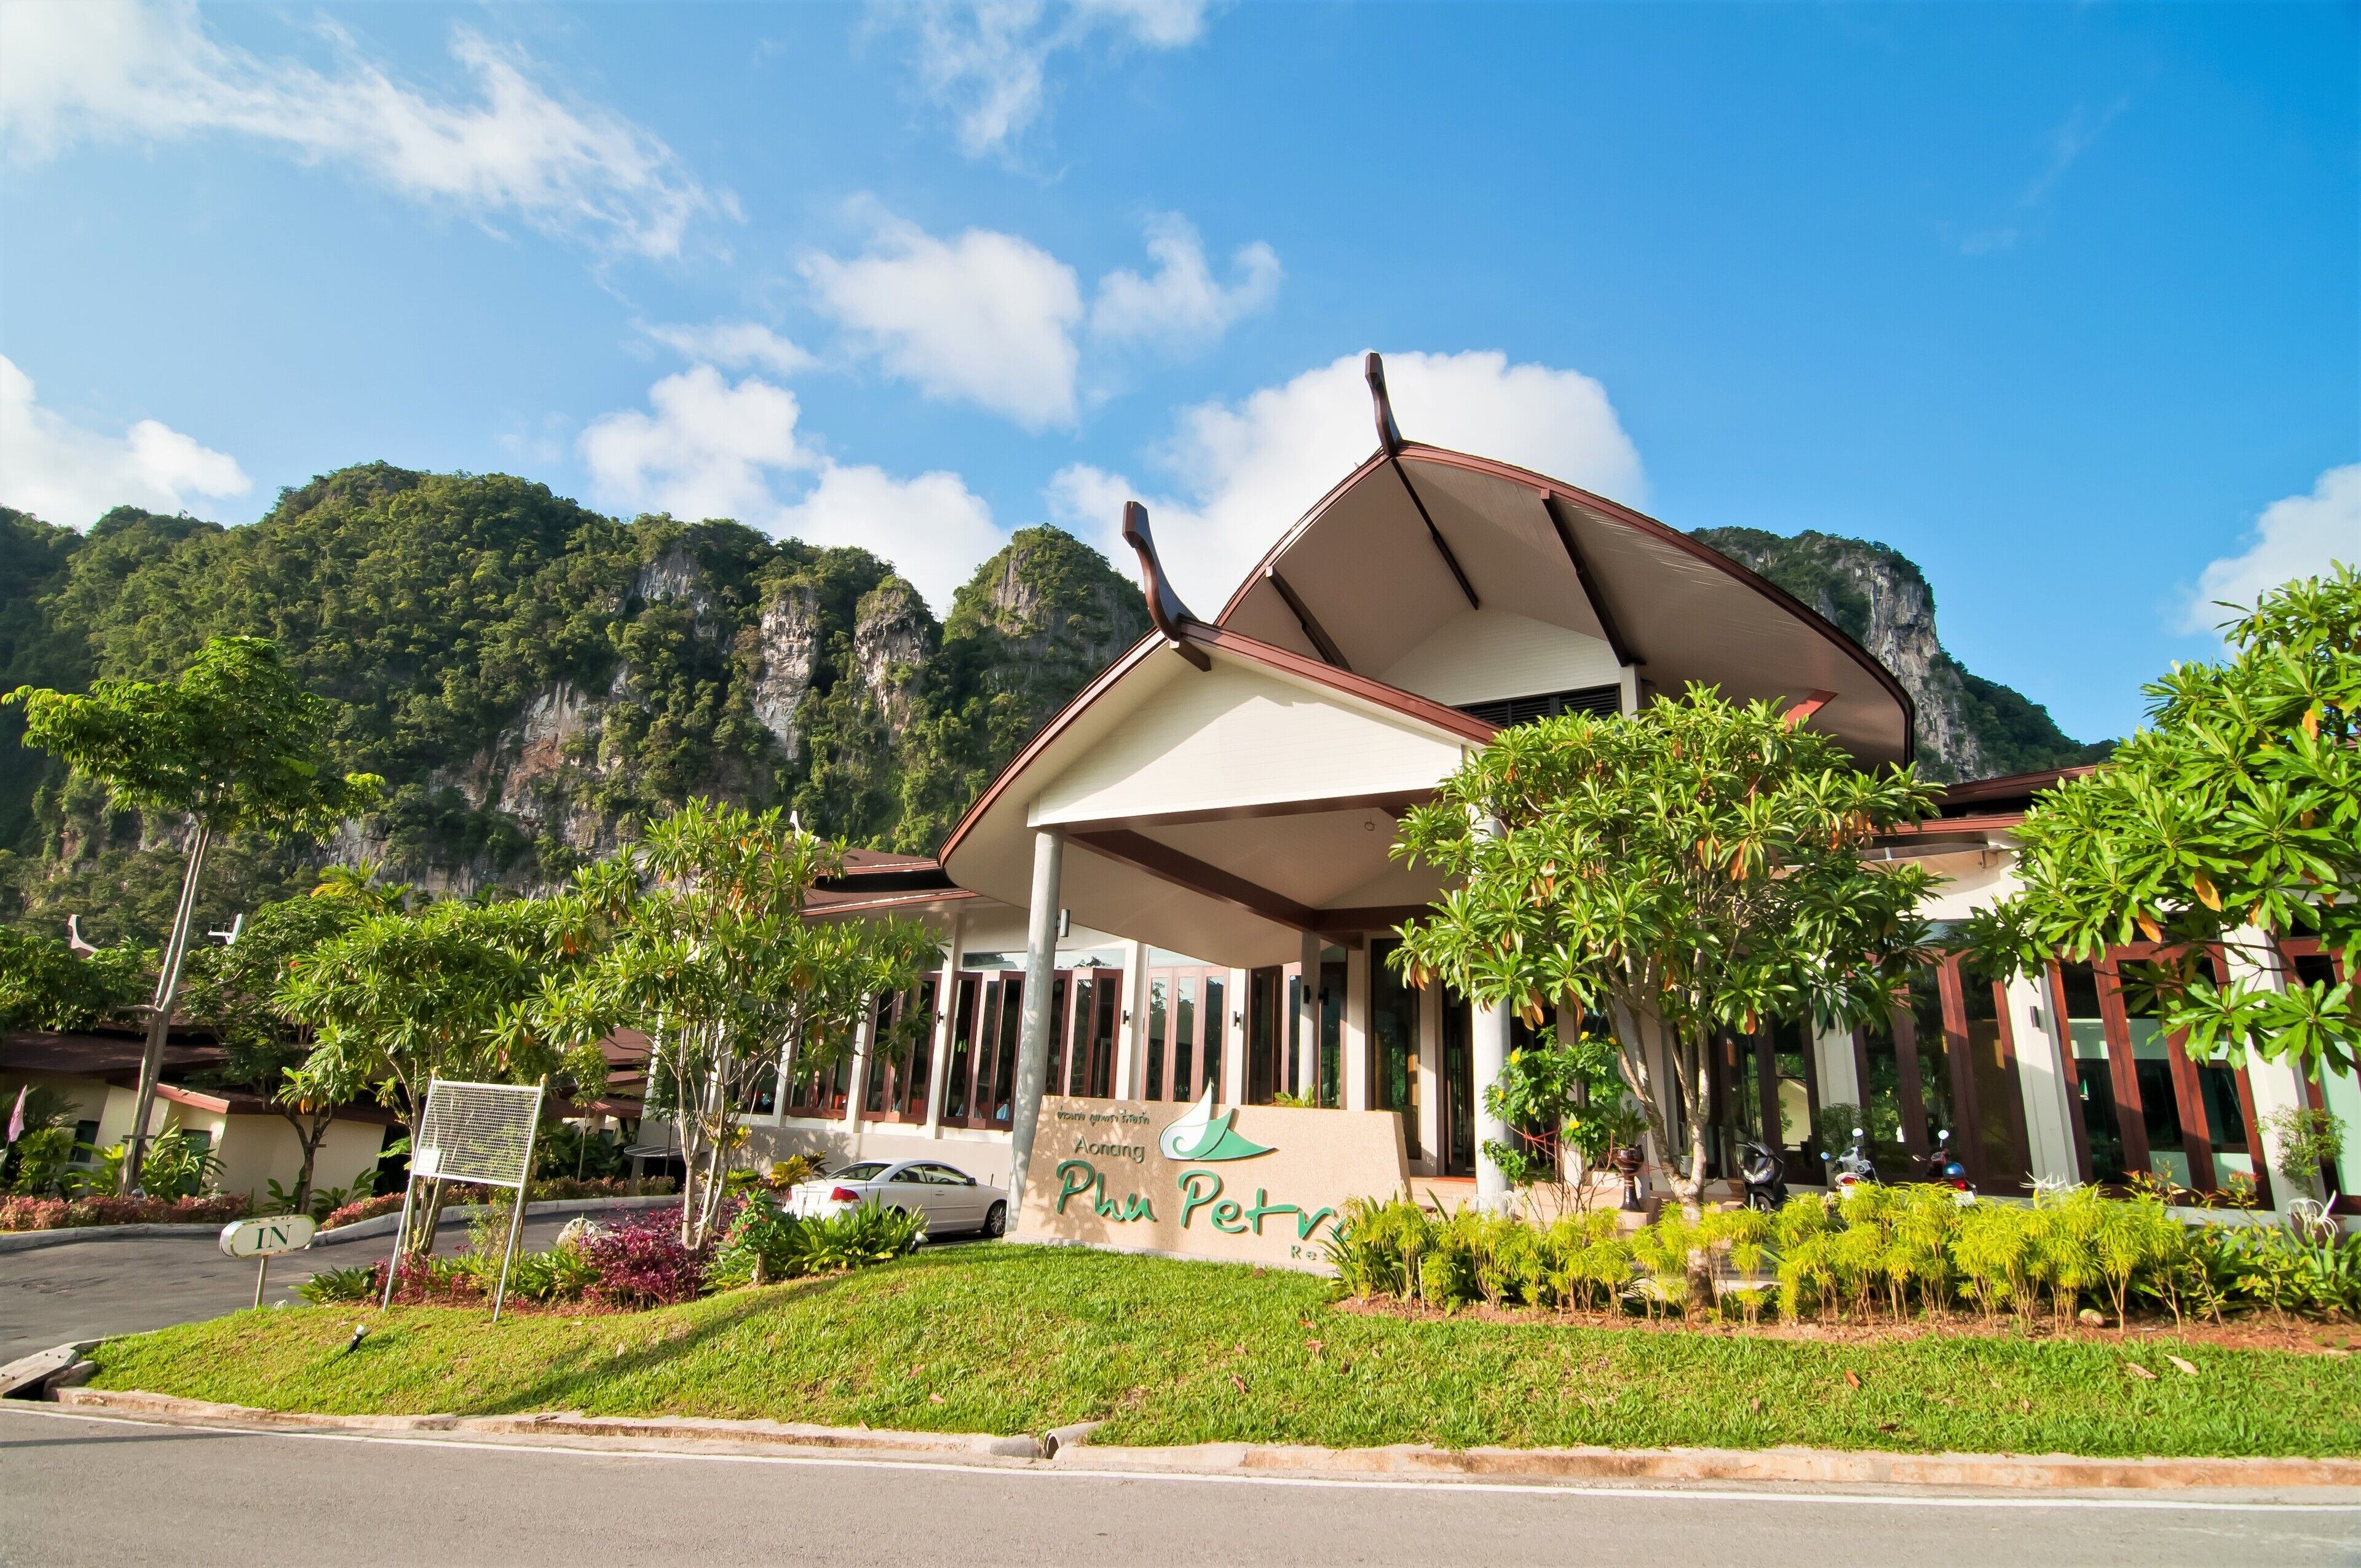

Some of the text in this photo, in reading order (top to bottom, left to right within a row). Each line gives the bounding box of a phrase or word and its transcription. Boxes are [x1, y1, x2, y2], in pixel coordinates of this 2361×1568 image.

[1075, 1136, 1144, 1163] Aonang
[1056, 1160, 1157, 1222] Phu
[255, 1224, 293, 1249] IN
